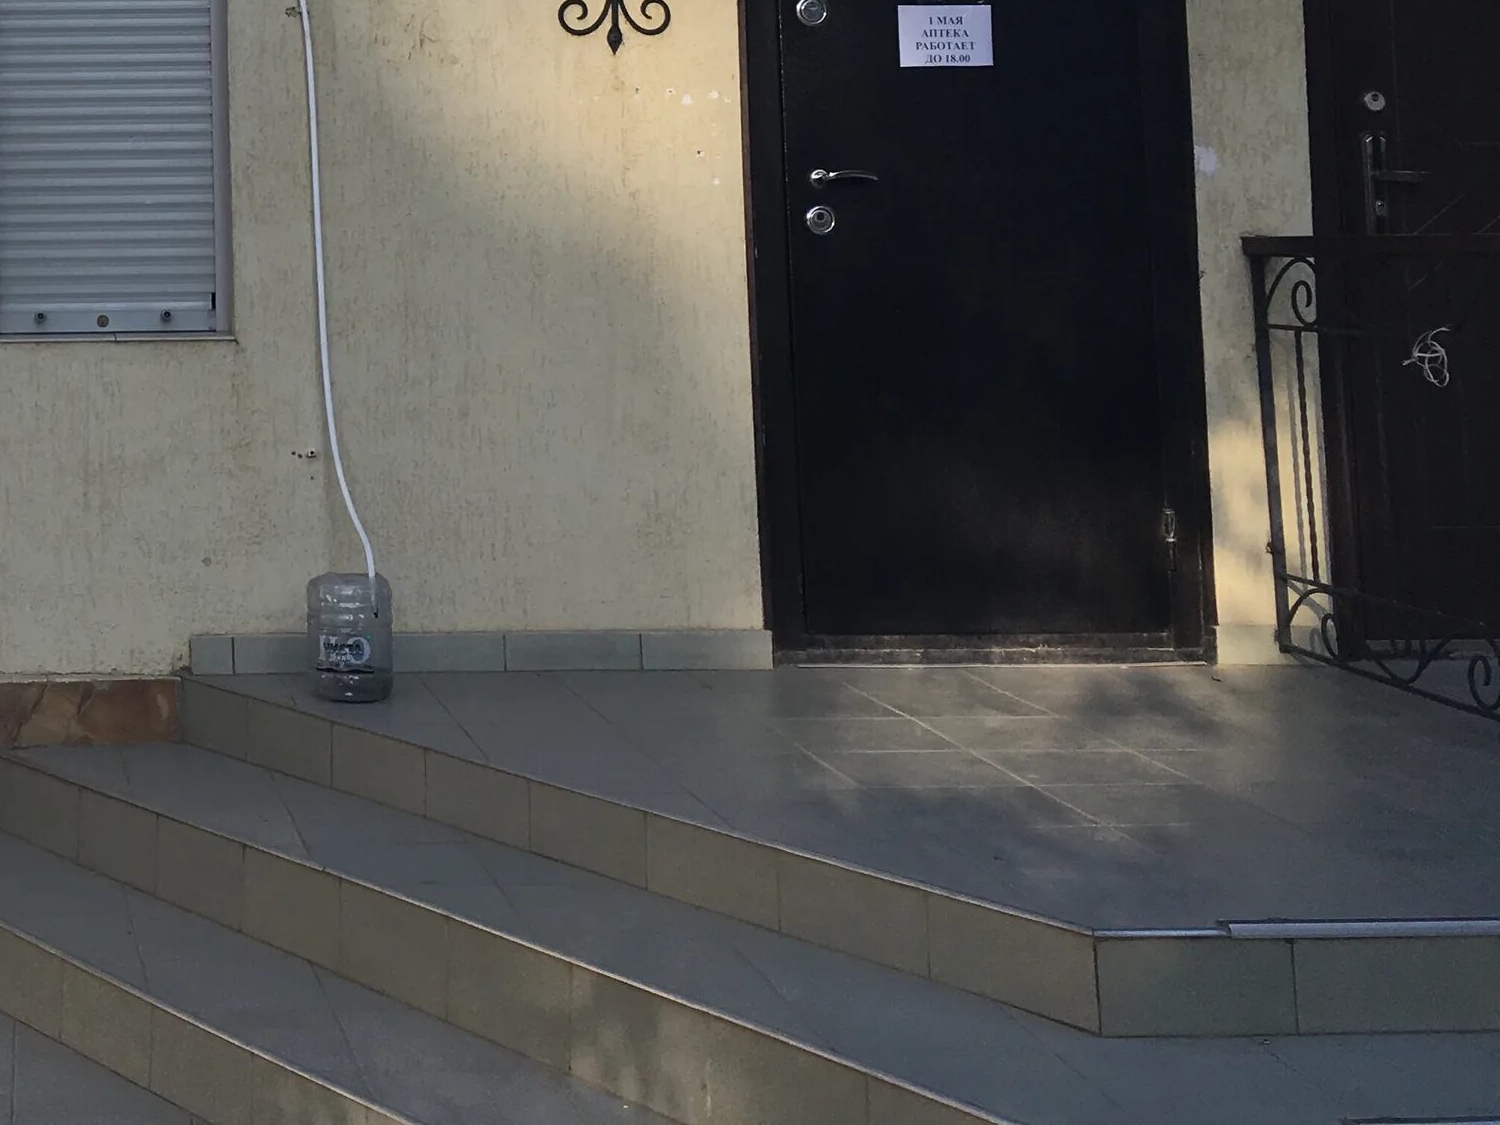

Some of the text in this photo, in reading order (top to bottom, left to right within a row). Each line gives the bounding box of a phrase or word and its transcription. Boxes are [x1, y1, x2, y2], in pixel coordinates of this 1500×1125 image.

[936, 16, 964, 25] МАЯ
[921, 28, 969, 38] АПТЕКА
[915, 41, 976, 51] РАБОТАЕТ
[924, 54, 971, 64] ДО 18.00
